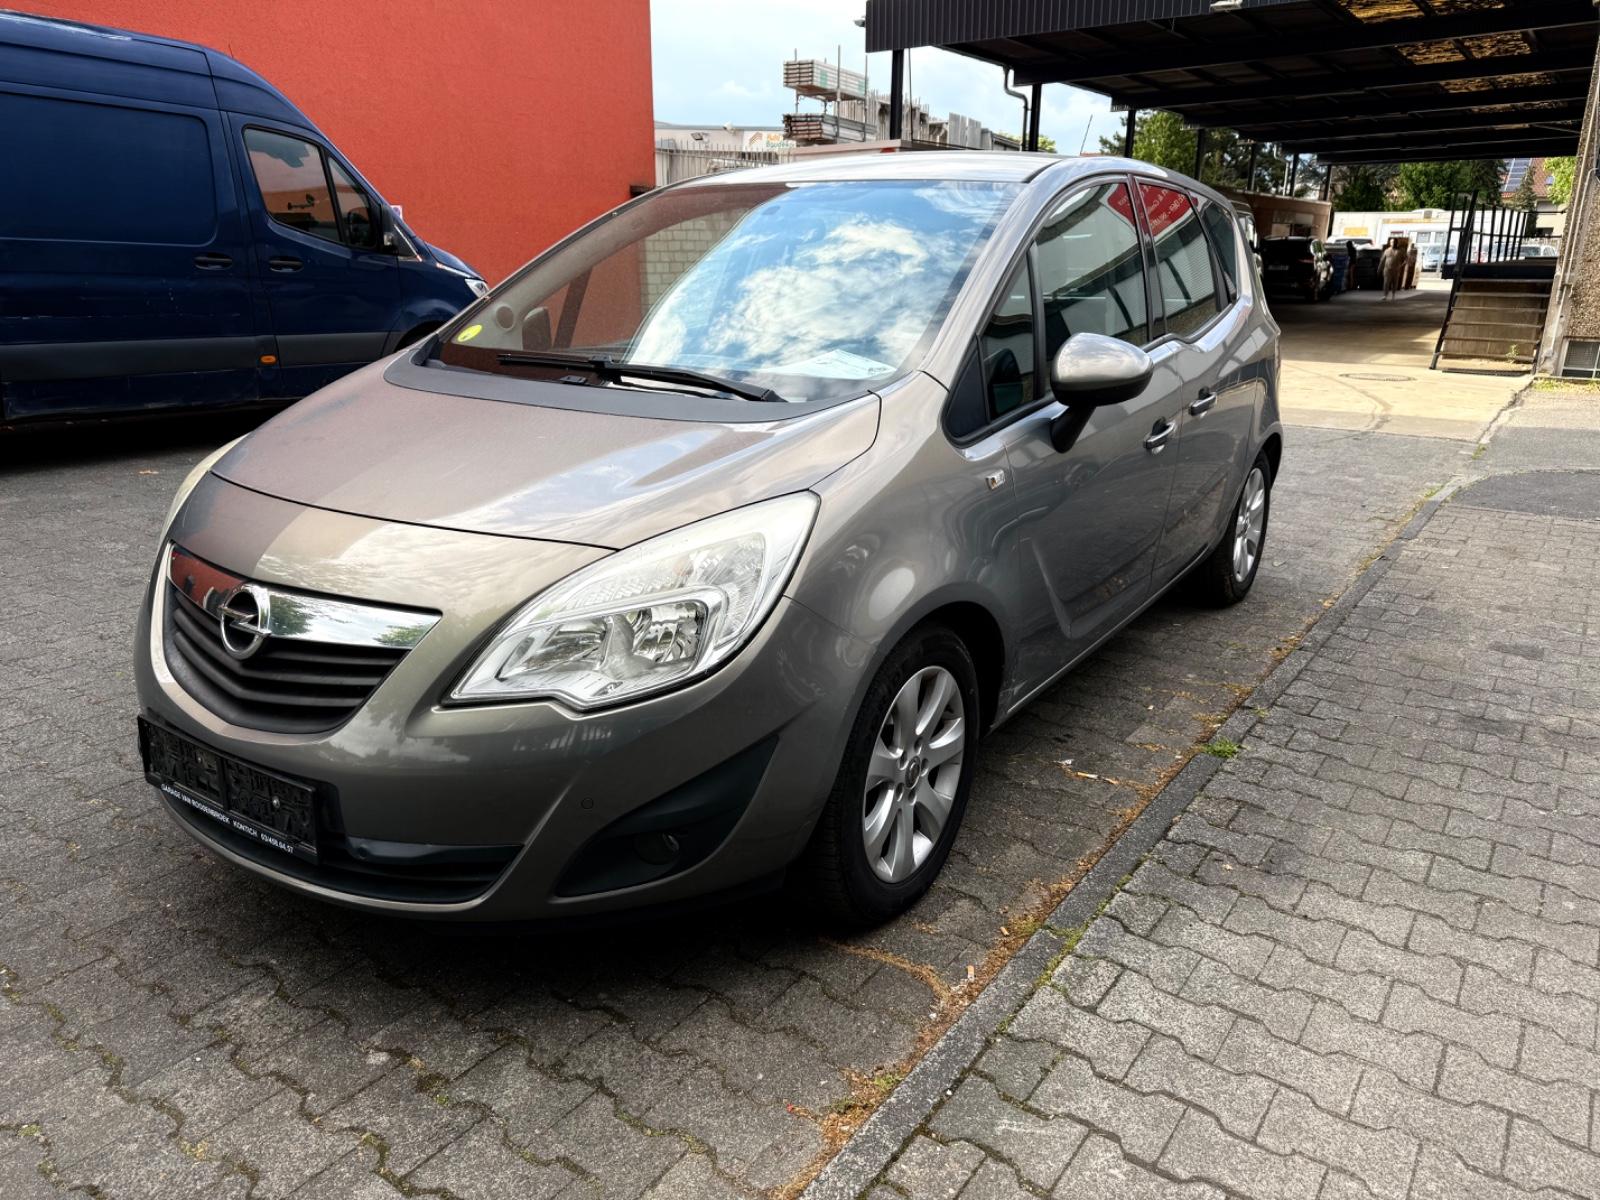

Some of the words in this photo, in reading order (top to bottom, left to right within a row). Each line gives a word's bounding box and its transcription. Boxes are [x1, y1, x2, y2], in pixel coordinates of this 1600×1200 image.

[161, 783, 181, 799] GARAGE
[181, 793, 192, 805] VAN
[233, 820, 259, 837] KONTICH
